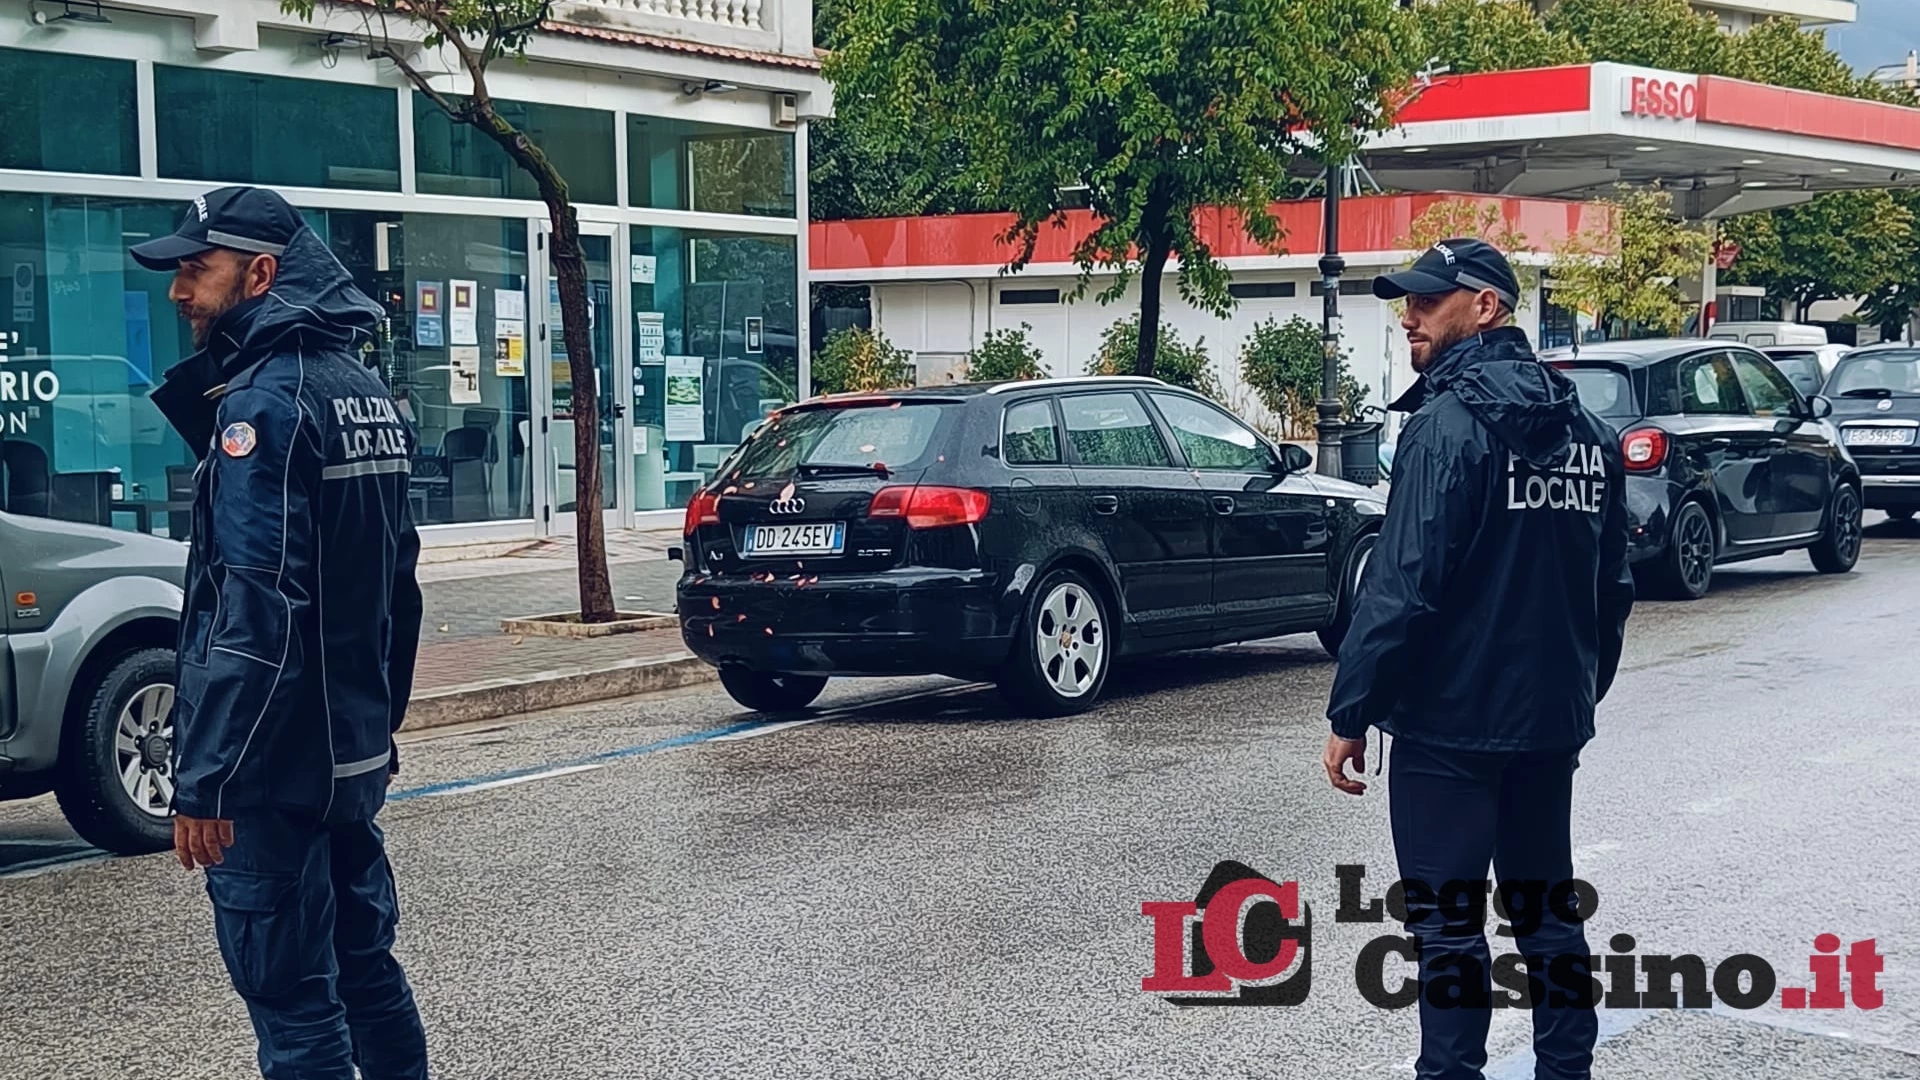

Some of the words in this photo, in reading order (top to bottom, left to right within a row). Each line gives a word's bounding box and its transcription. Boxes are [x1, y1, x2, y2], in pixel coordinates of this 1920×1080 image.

[1630, 76, 1698, 118] ESSO
[0, 370, 60, 402] RIO
[0, 411, 27, 435] N
[332, 396, 400, 426] POLIZIA
[1507, 443, 1606, 478] PZIA
[1507, 475, 1605, 513] LOCALE
[757, 527, 776, 549] DD
[781, 525, 834, 547] 245EV
